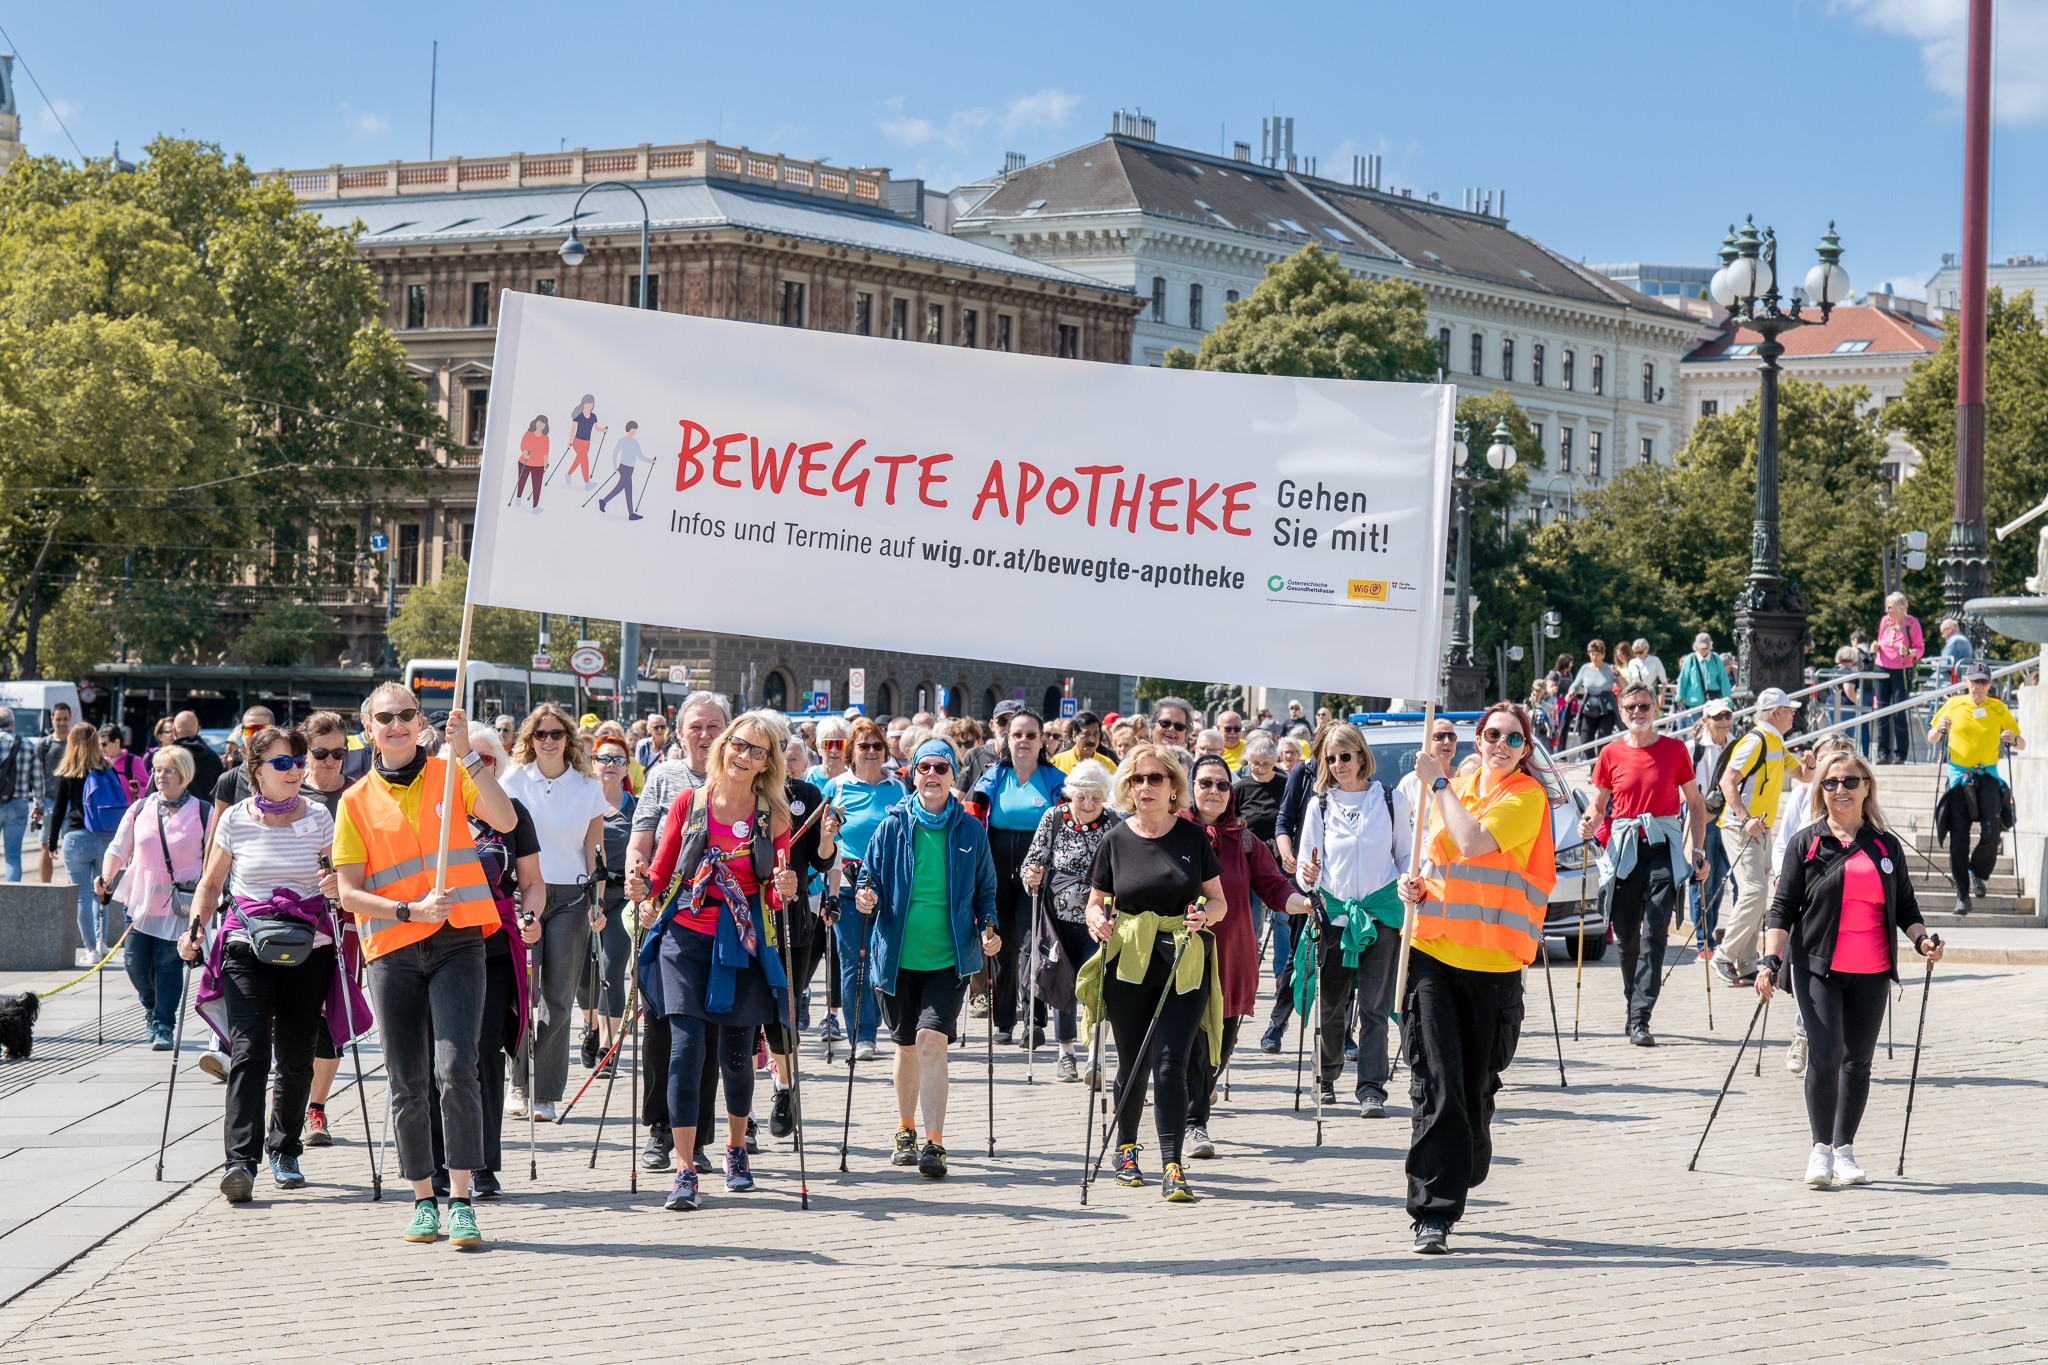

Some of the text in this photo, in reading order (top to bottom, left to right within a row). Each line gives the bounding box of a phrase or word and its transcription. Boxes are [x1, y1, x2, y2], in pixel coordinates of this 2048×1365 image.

[675, 419, 1257, 537] BEWEGTE APOTHEKE
[1277, 479, 1367, 514] Gehen
[670, 509, 1245, 590] Infos und Termine auf wig.or.at/bewegte-apotheke
[1273, 517, 1389, 555] Sie mit!
[1286, 585, 1335, 595] Gesundheitskasse
[1287, 578, 1328, 588] Österreichische
[1353, 584, 1370, 594] WiG
